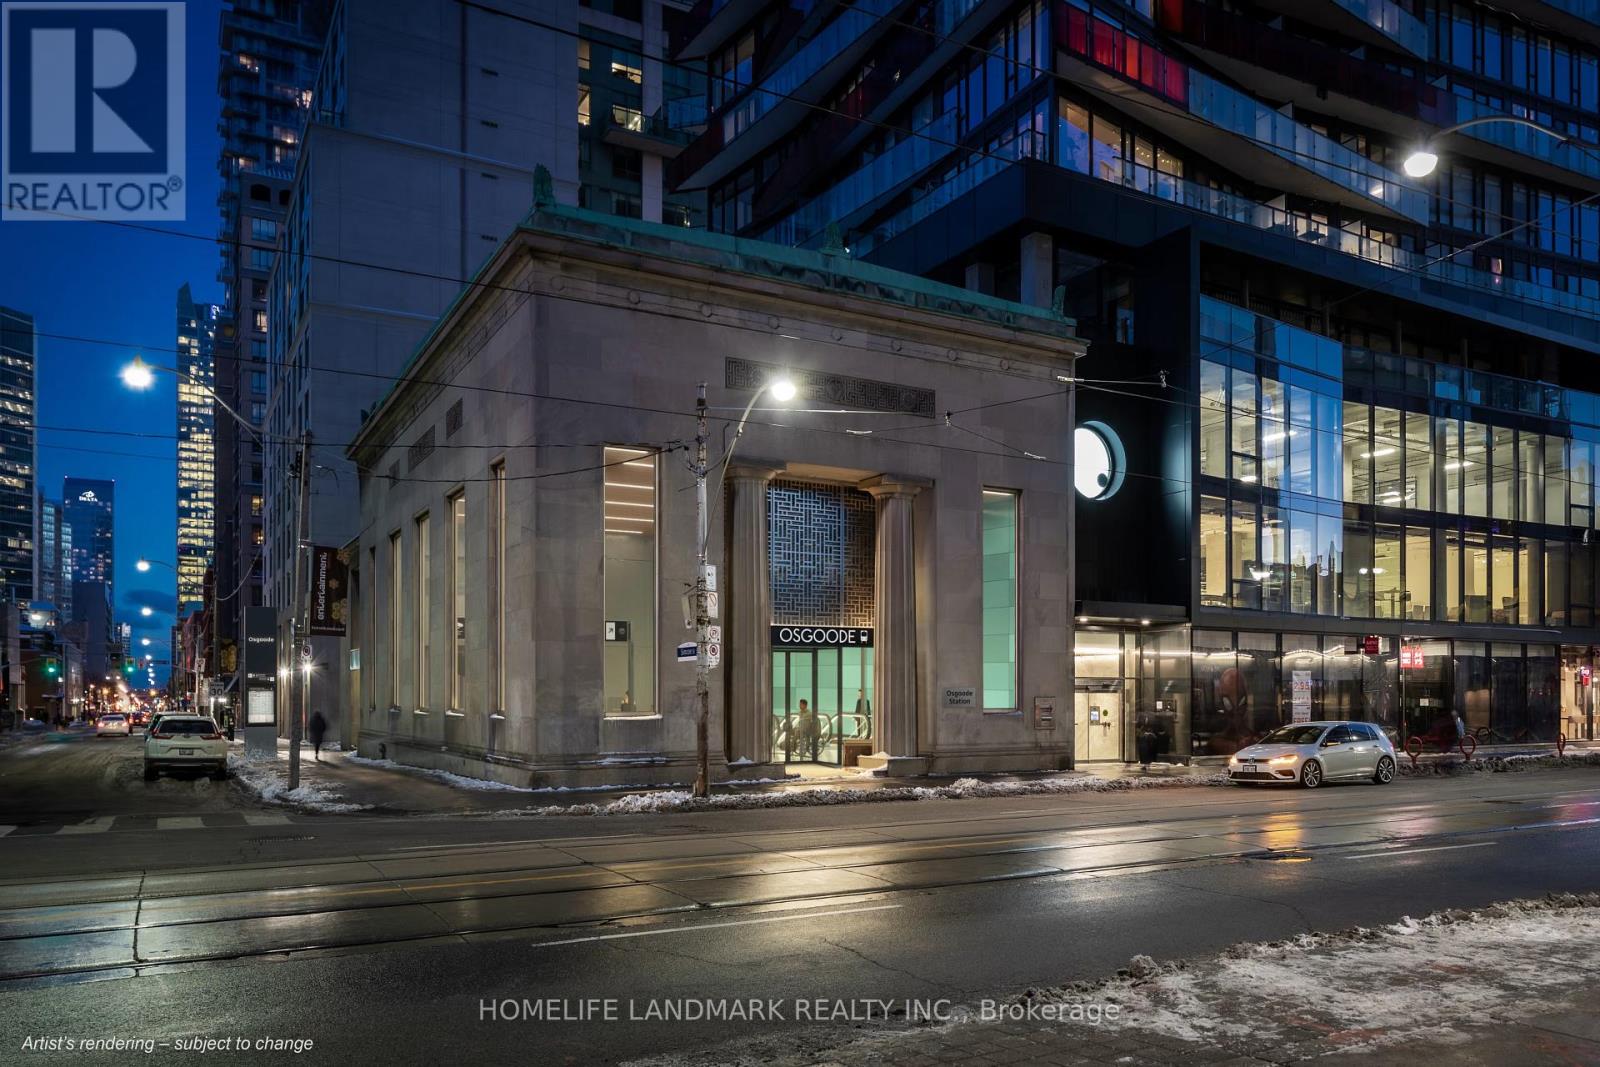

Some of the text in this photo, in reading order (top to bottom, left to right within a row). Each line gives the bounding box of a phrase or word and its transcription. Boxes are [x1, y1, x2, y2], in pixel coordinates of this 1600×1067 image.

[316, 551, 329, 621] entertainment
[779, 628, 856, 644] OSGOODE
[211, 688, 223, 696] 30
[946, 690, 973, 698] Osgoode
